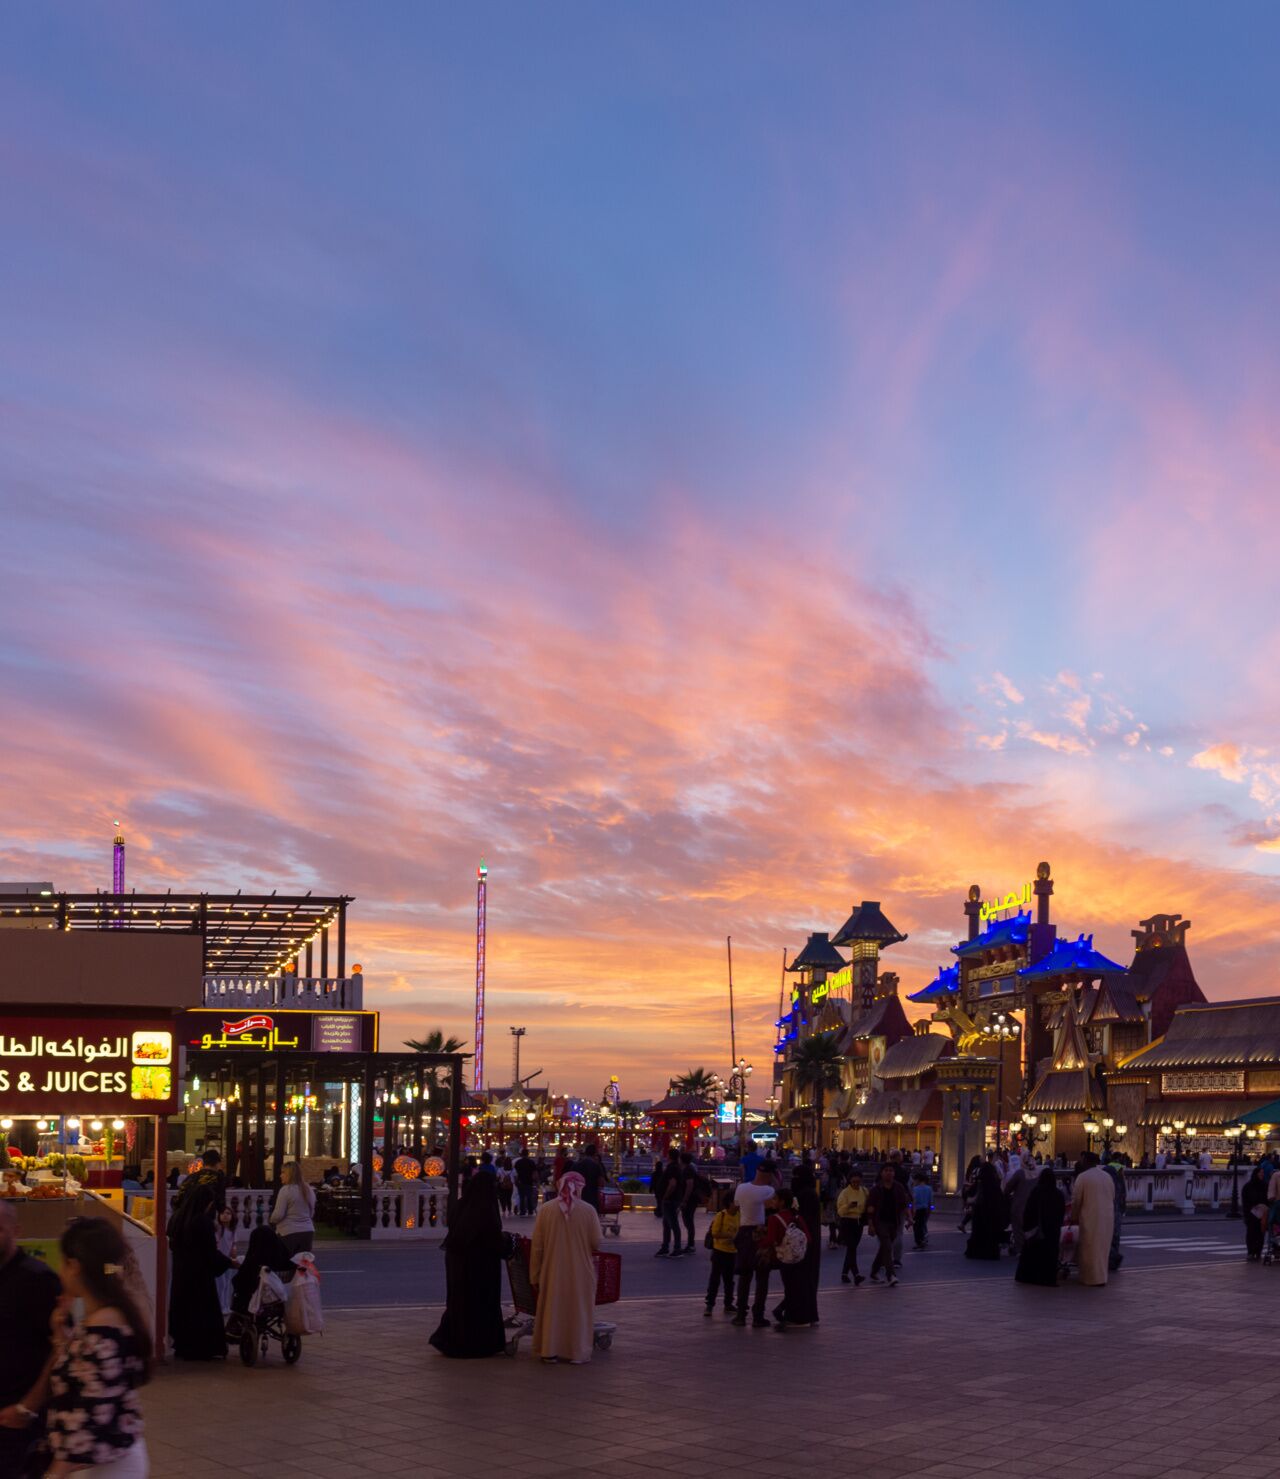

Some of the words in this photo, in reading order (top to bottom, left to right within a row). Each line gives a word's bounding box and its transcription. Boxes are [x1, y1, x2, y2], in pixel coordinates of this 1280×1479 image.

[979, 883, 1031, 921] الصين
[830, 968, 852, 990] CHINA
[17, 1071, 36, 1092] &
[41, 1070, 127, 1093] JUICES
